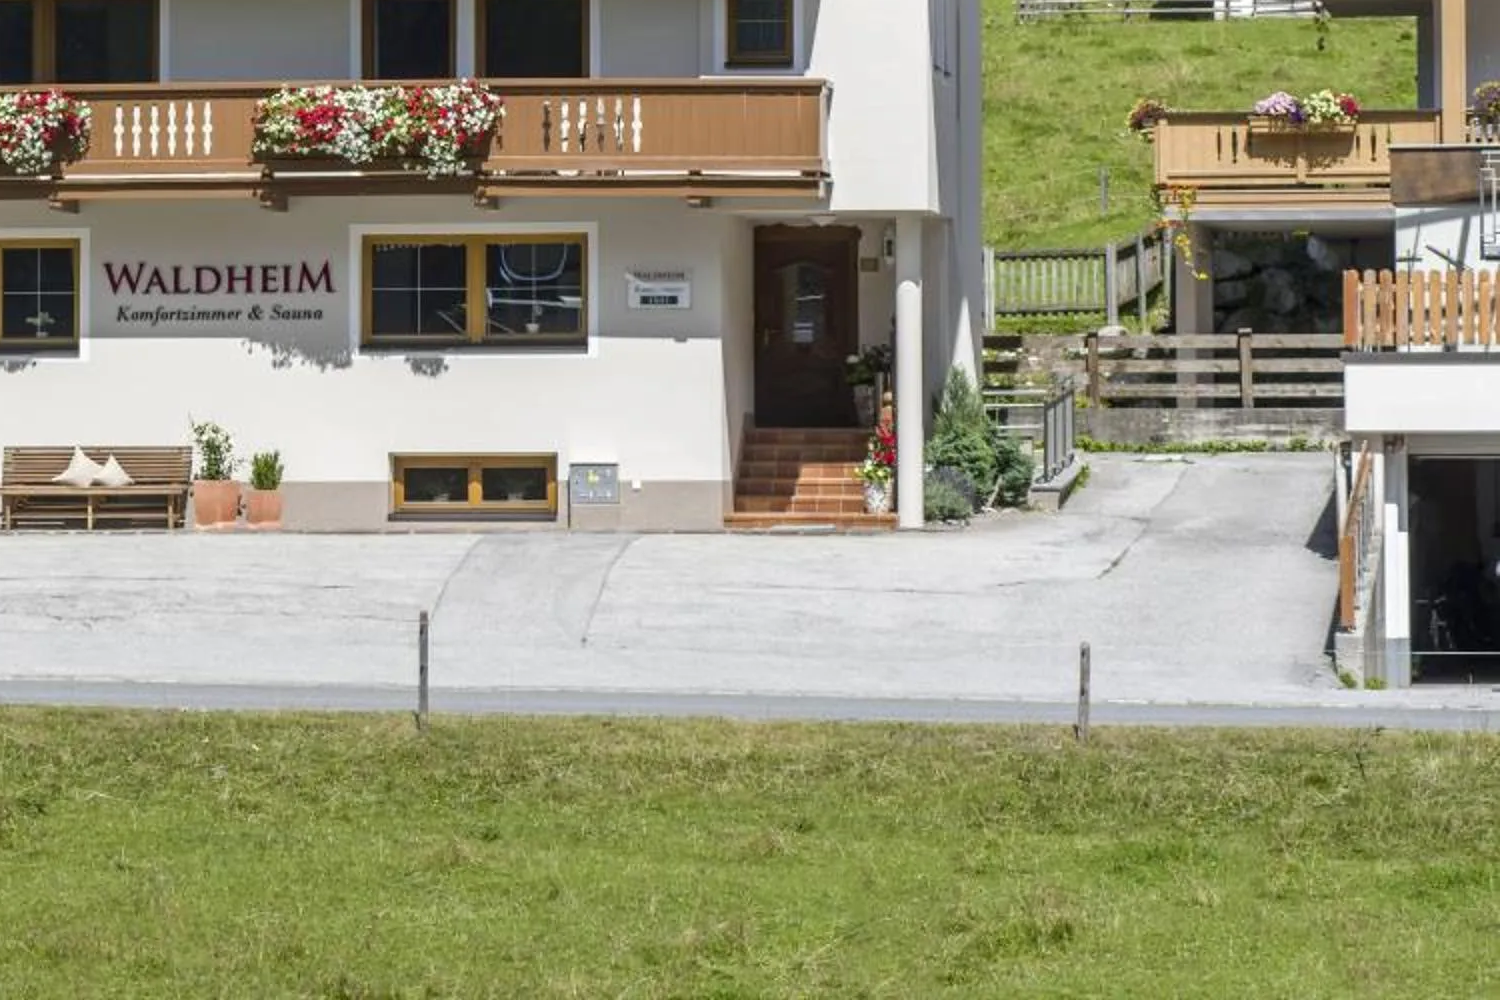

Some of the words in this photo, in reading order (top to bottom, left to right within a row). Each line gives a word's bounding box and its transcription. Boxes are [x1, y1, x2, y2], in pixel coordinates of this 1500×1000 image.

[103, 259, 337, 295] WALDHEIM
[116, 305, 242, 326] Komfortzimmer
[247, 305, 263, 321] &
[269, 305, 324, 321] Sauna
